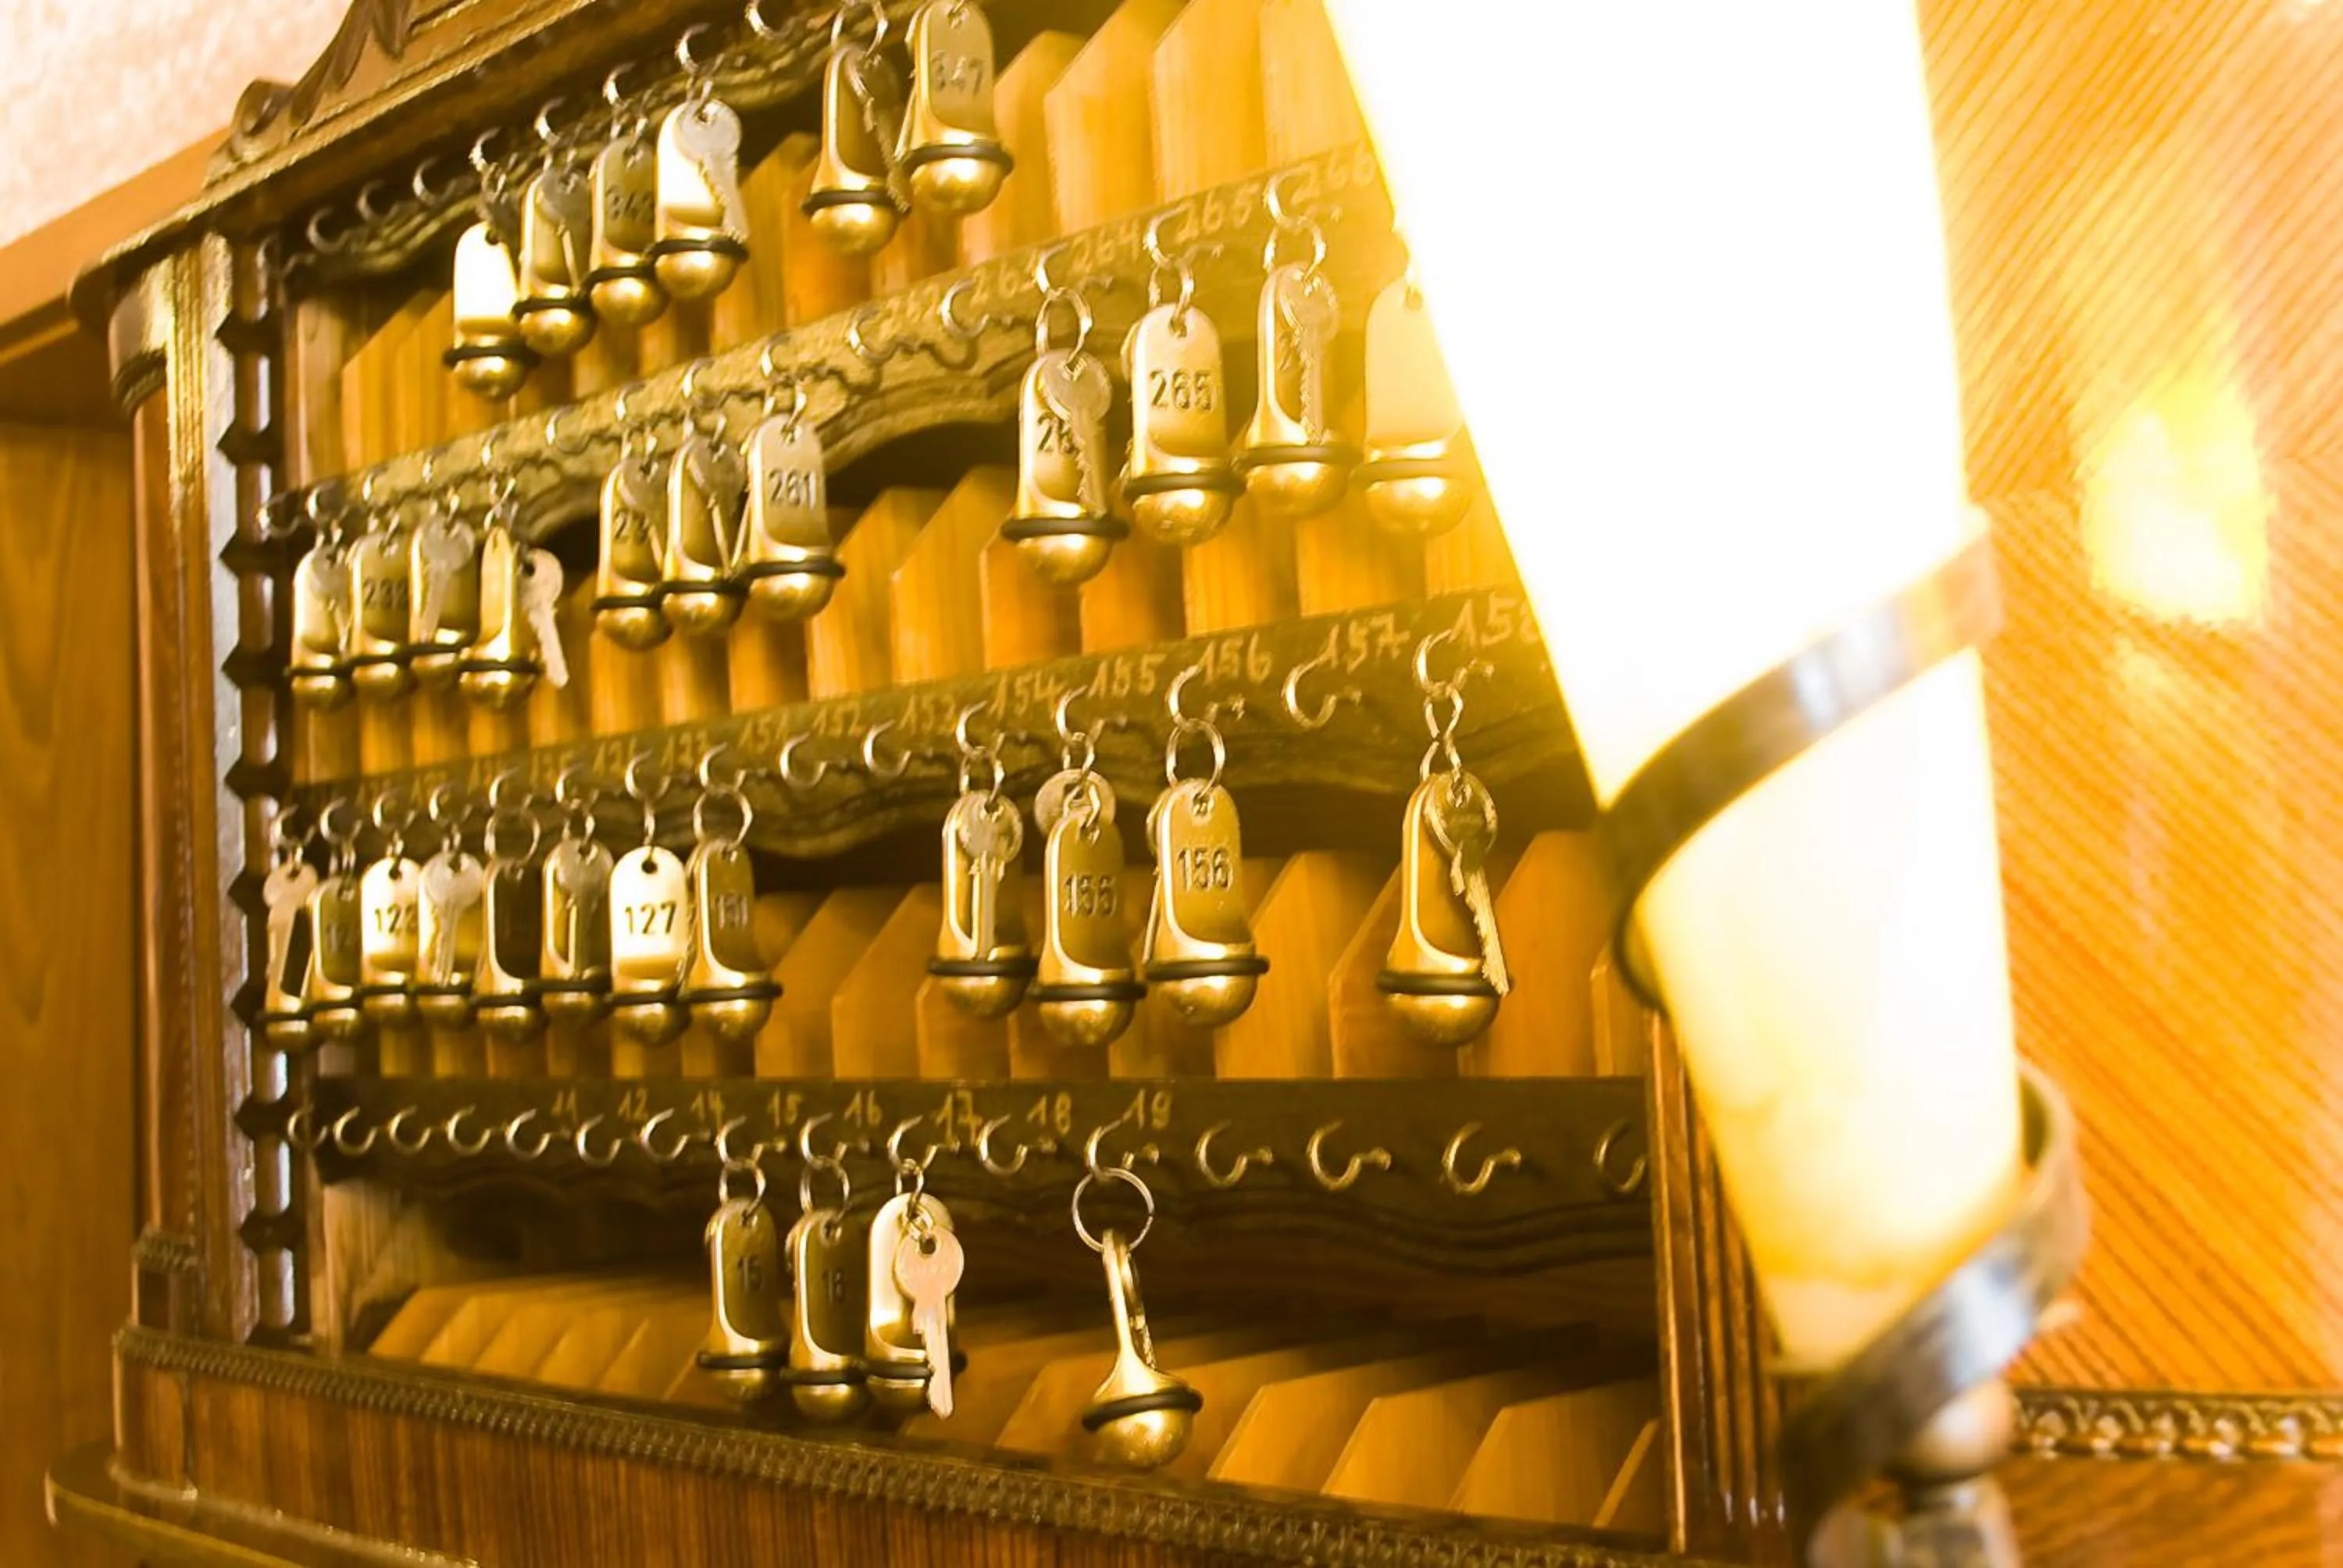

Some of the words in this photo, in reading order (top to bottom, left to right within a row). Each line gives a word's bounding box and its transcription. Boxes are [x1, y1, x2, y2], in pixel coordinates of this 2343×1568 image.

[1149, 368, 1217, 413] 265
[767, 466, 816, 510] 261
[986, 670, 1067, 722] 154
[1197, 631, 1273, 686] 156
[1321, 613, 1409, 674] 157
[1176, 845, 1234, 893] 156
[625, 900, 678, 935] 127
[617, 1085, 650, 1123] 12
[765, 1088, 803, 1131] 15
[843, 1088, 883, 1129] 16
[1025, 1090, 1073, 1137] 18
[1121, 1088, 1174, 1132] 19
